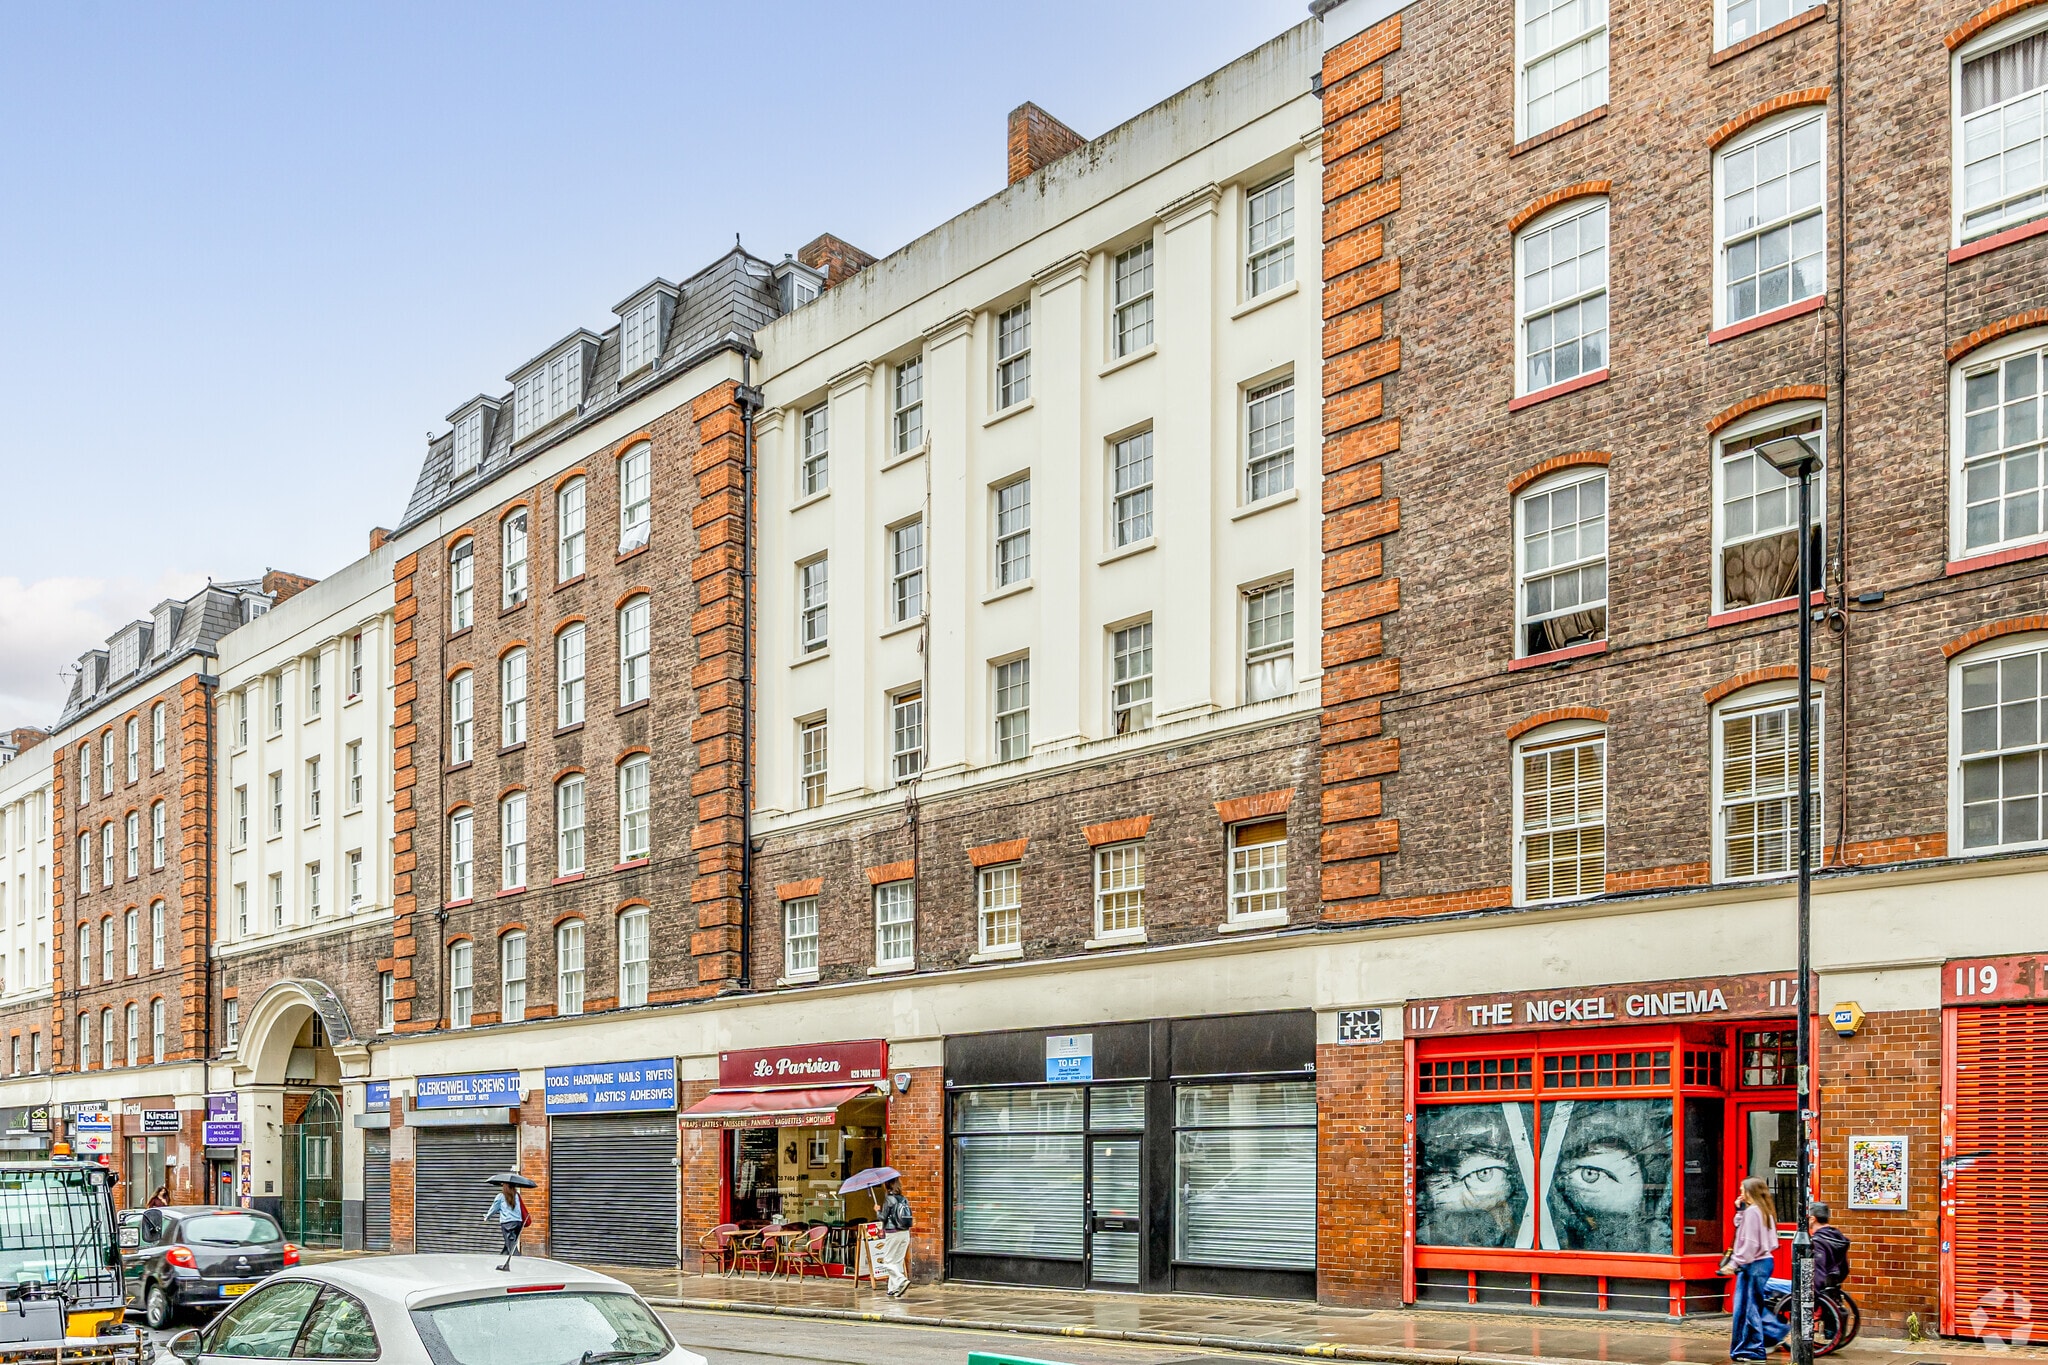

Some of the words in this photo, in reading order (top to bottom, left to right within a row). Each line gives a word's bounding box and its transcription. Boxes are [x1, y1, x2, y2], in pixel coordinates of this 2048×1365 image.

[1956, 965, 1998, 996] 119
[1411, 1005, 1440, 1030] 117
[1467, 1004, 1512, 1028] THE
[1526, 997, 1614, 1022] NICKEL
[1626, 988, 1728, 1017] CINEMA
[1836, 1012, 1851, 1021] ADT
[753, 1058, 774, 1077] Le
[776, 1057, 840, 1075] Parisien
[1069, 1058, 1081, 1066] LET
[546, 1076, 569, 1087] TOOLS
[574, 1073, 613, 1086] HARDWARE
[618, 1071, 640, 1083] NAILS
[646, 1069, 673, 1081] RIVETS
[418, 1080, 469, 1096] CLERKENWELL
[472, 1078, 505, 1093] SCREWS
[508, 1077, 520, 1092] LTD
[630, 1088, 673, 1101] ADHESIVES
[78, 1113, 110, 1123] FedEx
[146, 1112, 177, 1120] Kirstal
[775, 1117, 802, 1125] BAGUETTES
